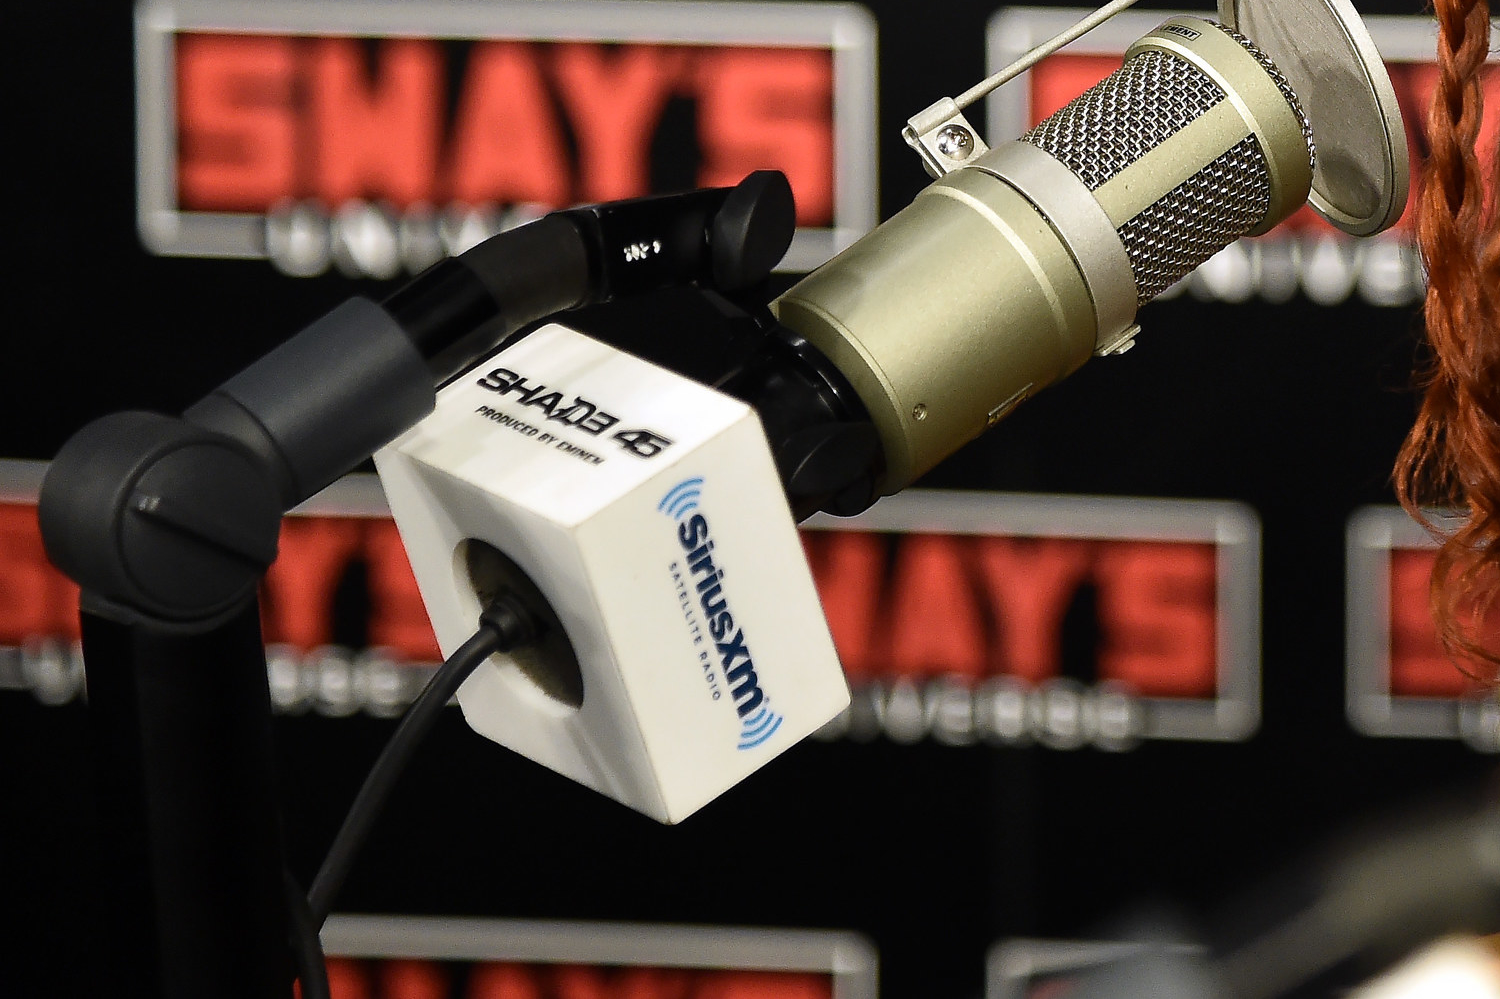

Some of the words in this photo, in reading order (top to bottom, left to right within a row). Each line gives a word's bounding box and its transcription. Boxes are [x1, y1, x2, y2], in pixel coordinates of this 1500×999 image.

[475, 405, 539, 438] PRODUCED
[536, 432, 558, 446] BY
[555, 440, 606, 467] EMINEM
[668, 562, 702, 646] SATELLITE
[699, 652, 722, 702] RADIO
